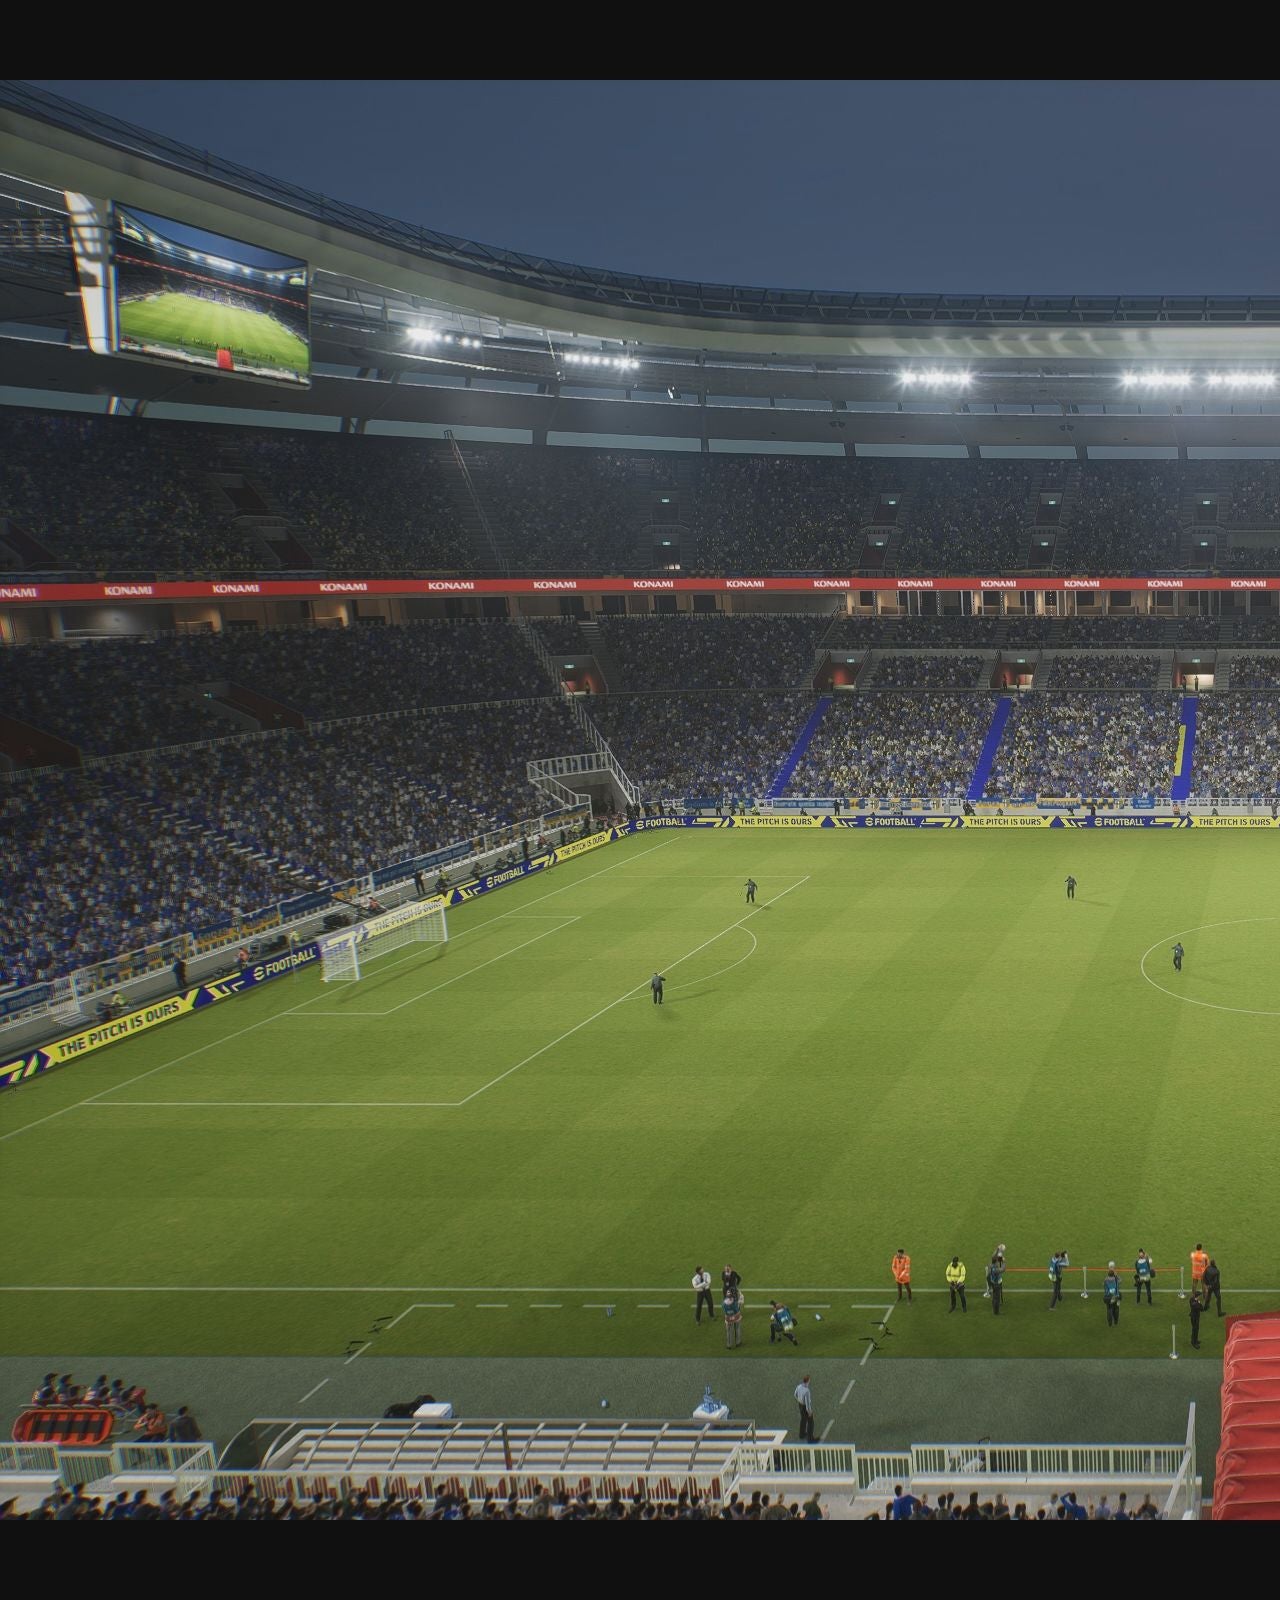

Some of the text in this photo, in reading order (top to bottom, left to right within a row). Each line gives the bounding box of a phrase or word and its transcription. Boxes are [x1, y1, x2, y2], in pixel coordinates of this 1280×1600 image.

[319, 583, 368, 591] KONAMI
[428, 581, 475, 589] KONAMI
[633, 580, 674, 588] KONAMI
[1063, 579, 1100, 587] KONAMI
[1147, 579, 1184, 587] KONAMI
[1230, 579, 1267, 587] KONAMI
[104, 586, 153, 595] KONAMI
[212, 584, 260, 593] KONAMI
[0, 588, 37, 598] NAMI
[58, 1000, 179, 1057] THE PITCH IS OURS
